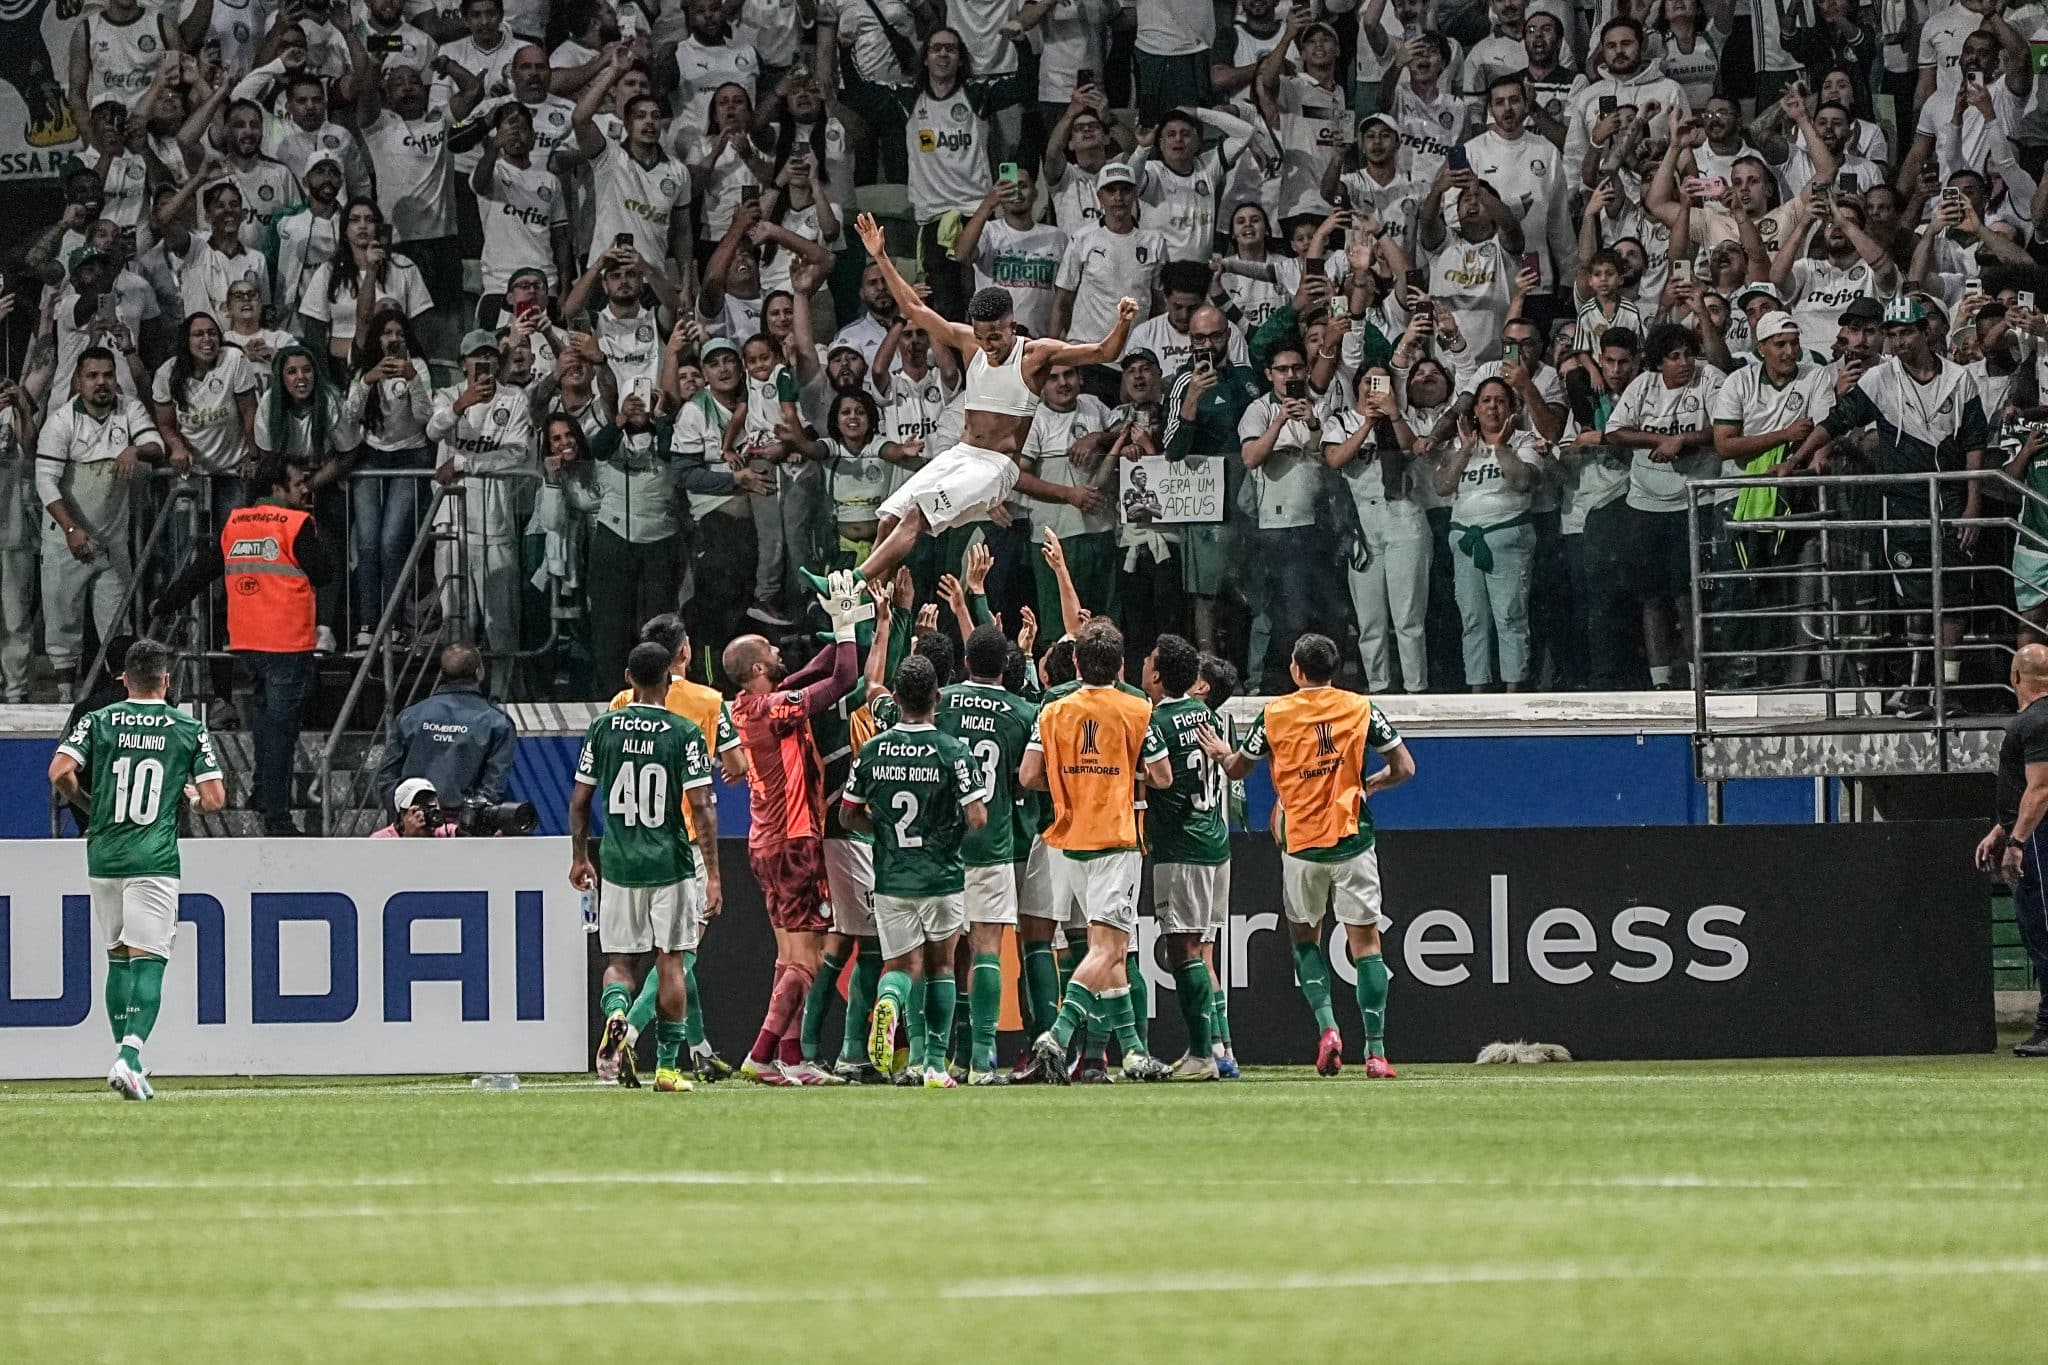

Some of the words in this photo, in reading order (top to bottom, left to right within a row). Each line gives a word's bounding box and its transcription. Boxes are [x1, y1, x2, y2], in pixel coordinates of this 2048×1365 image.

[937, 130, 972, 151] Agip
[1807, 288, 1865, 307] crefisa
[1198, 478, 1215, 493] UM
[1163, 496, 1215, 516] ADEUS
[961, 715, 997, 733] MICAEL
[118, 733, 166, 751] PAULINHO
[433, 734, 455, 743] CIVIL
[622, 739, 655, 755] ALLAN
[872, 766, 907, 781] MARCOS
[909, 767, 940, 783] ROCHA
[112, 757, 164, 825] 10
[608, 760, 668, 828] 40
[891, 790, 923, 848] 2
[1138, 874, 1749, 1018] prceless
